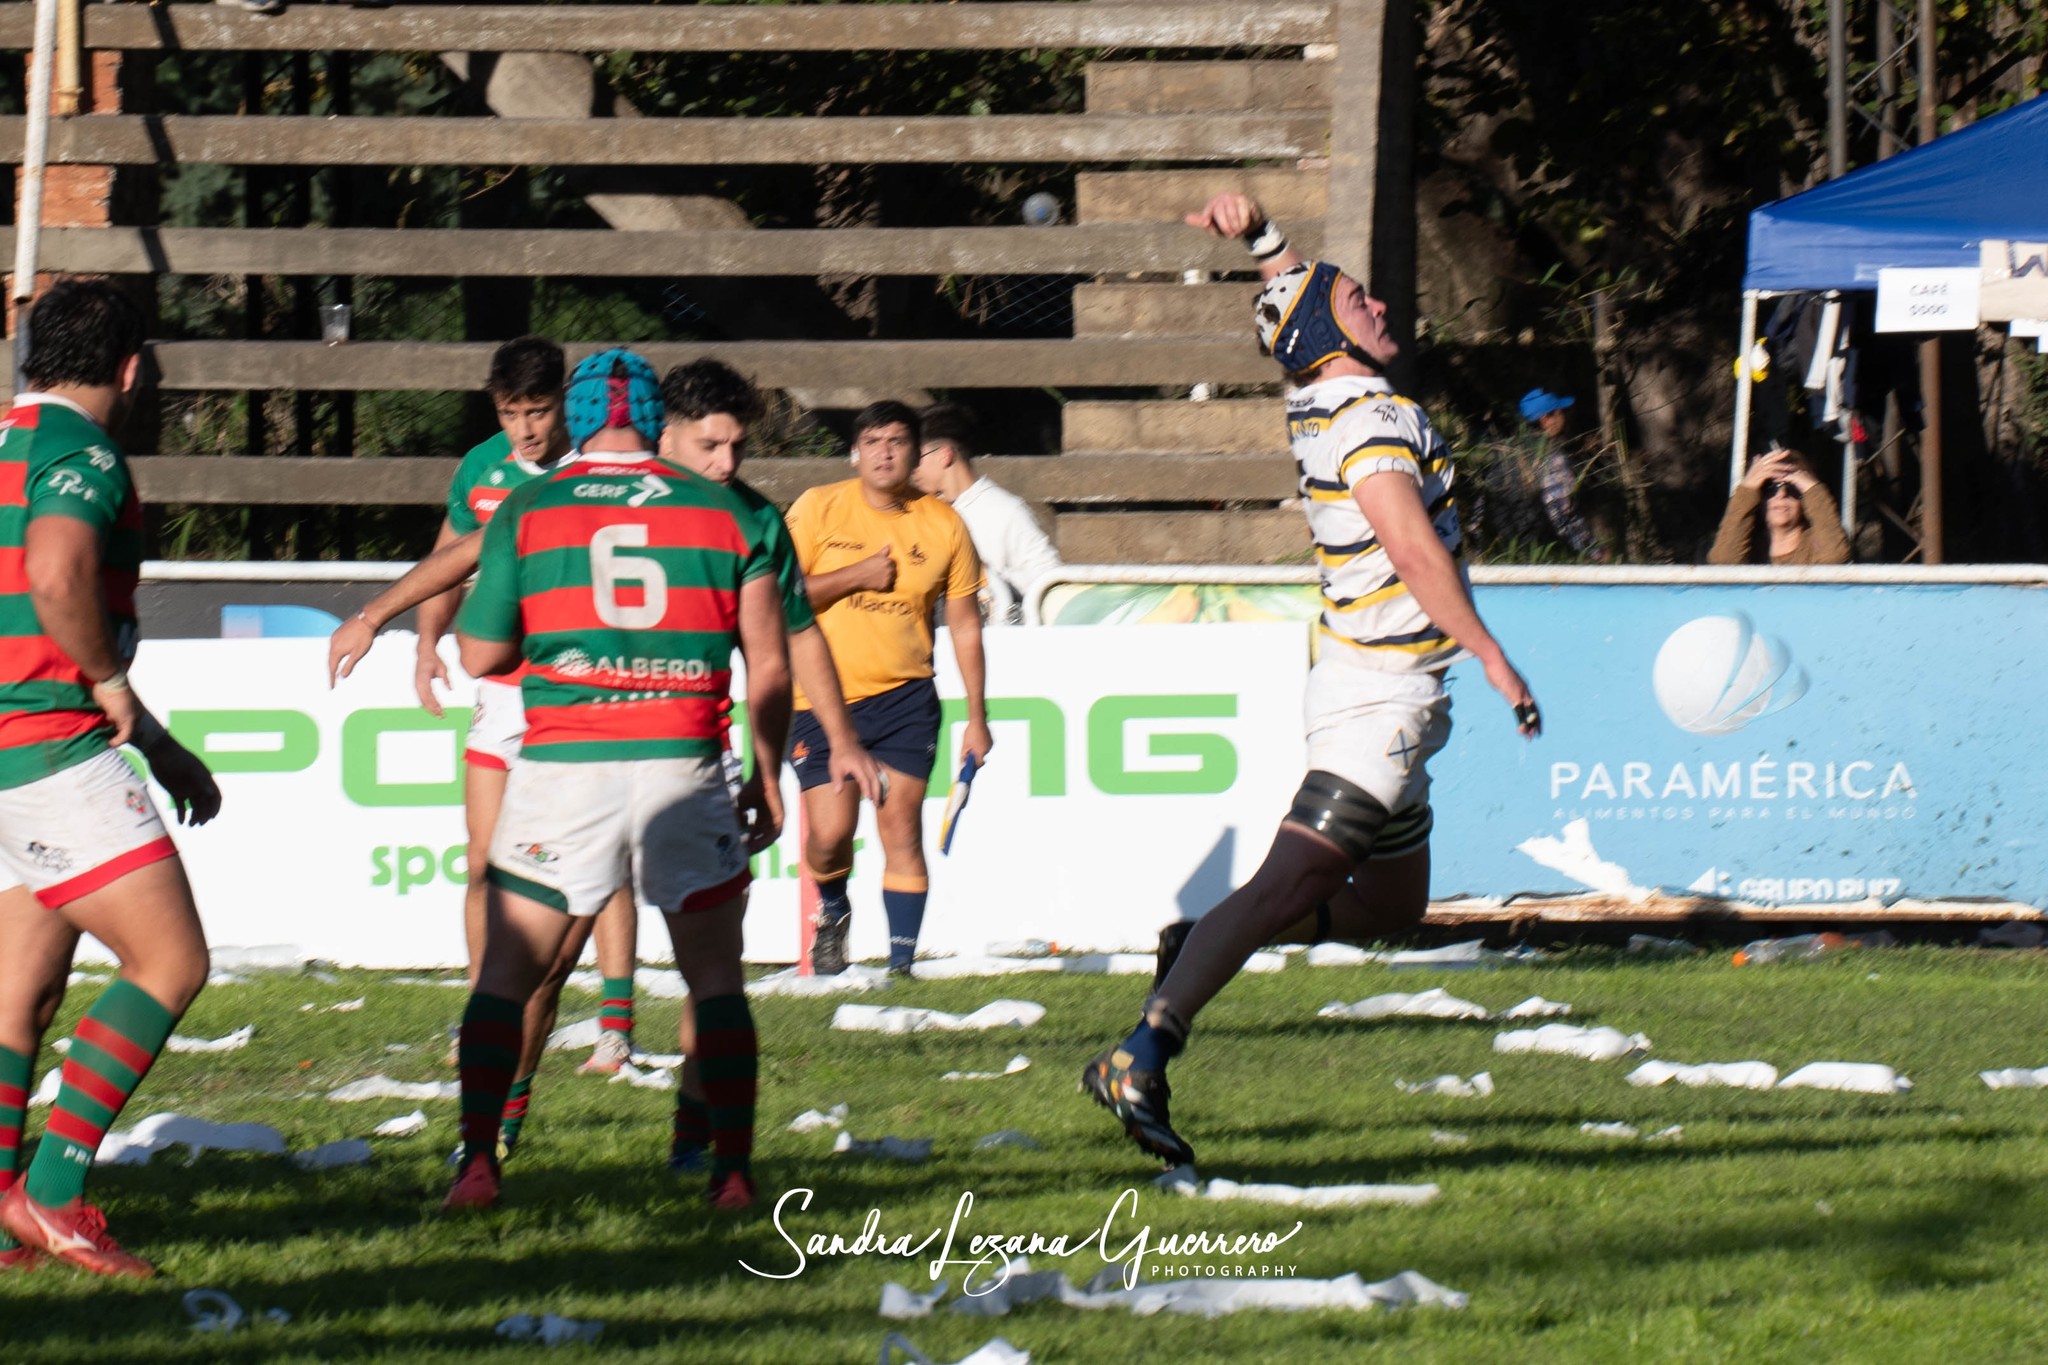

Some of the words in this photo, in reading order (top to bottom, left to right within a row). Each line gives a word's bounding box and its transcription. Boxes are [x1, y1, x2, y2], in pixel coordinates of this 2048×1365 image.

[589, 524, 668, 630] 6
[594, 656, 713, 681] ALBERDI
[1550, 753, 1918, 801] PARAMÉRICA
[1553, 806, 1695, 820] ALIMENTOS
[1708, 806, 1772, 820] PARA
[1786, 806, 1814, 820] EL
[1828, 806, 1918, 820] MUNDO
